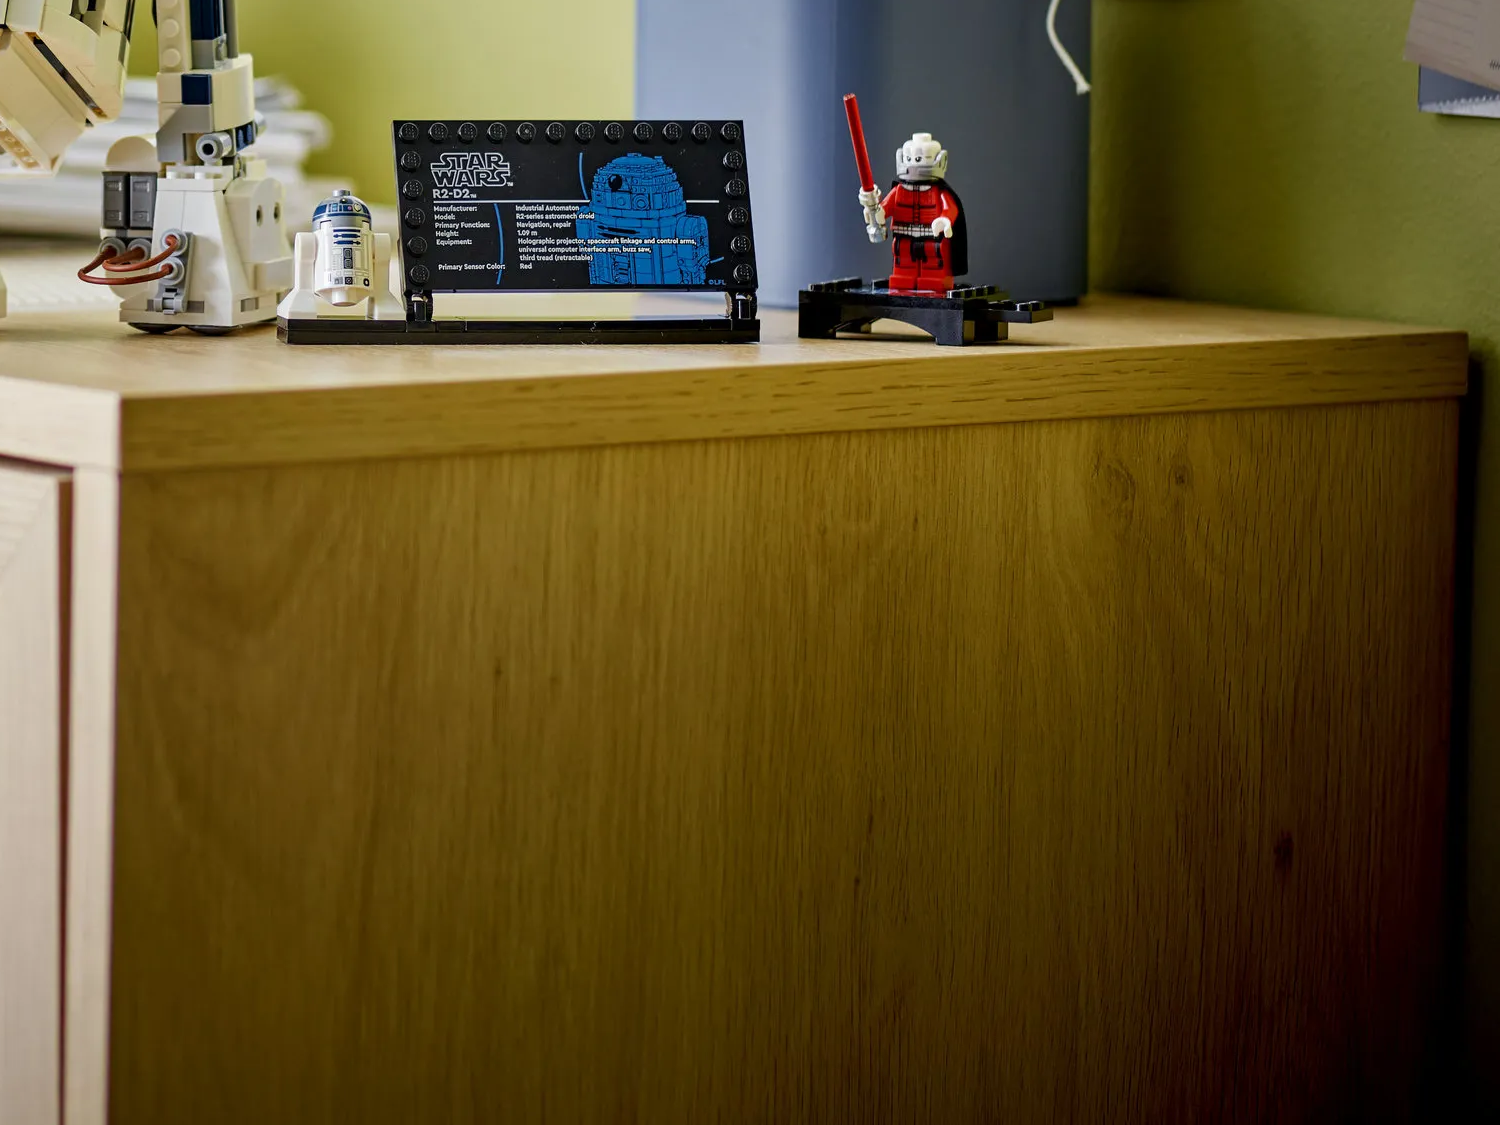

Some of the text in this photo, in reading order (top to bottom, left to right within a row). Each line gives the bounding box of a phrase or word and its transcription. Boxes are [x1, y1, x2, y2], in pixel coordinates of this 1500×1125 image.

[430, 152, 510, 170] STAR
[434, 222, 459, 230] Primary
[556, 238, 585, 246] projector,
[620, 238, 642, 246] linkage
[438, 263, 506, 272] Primary Sensor Color:
